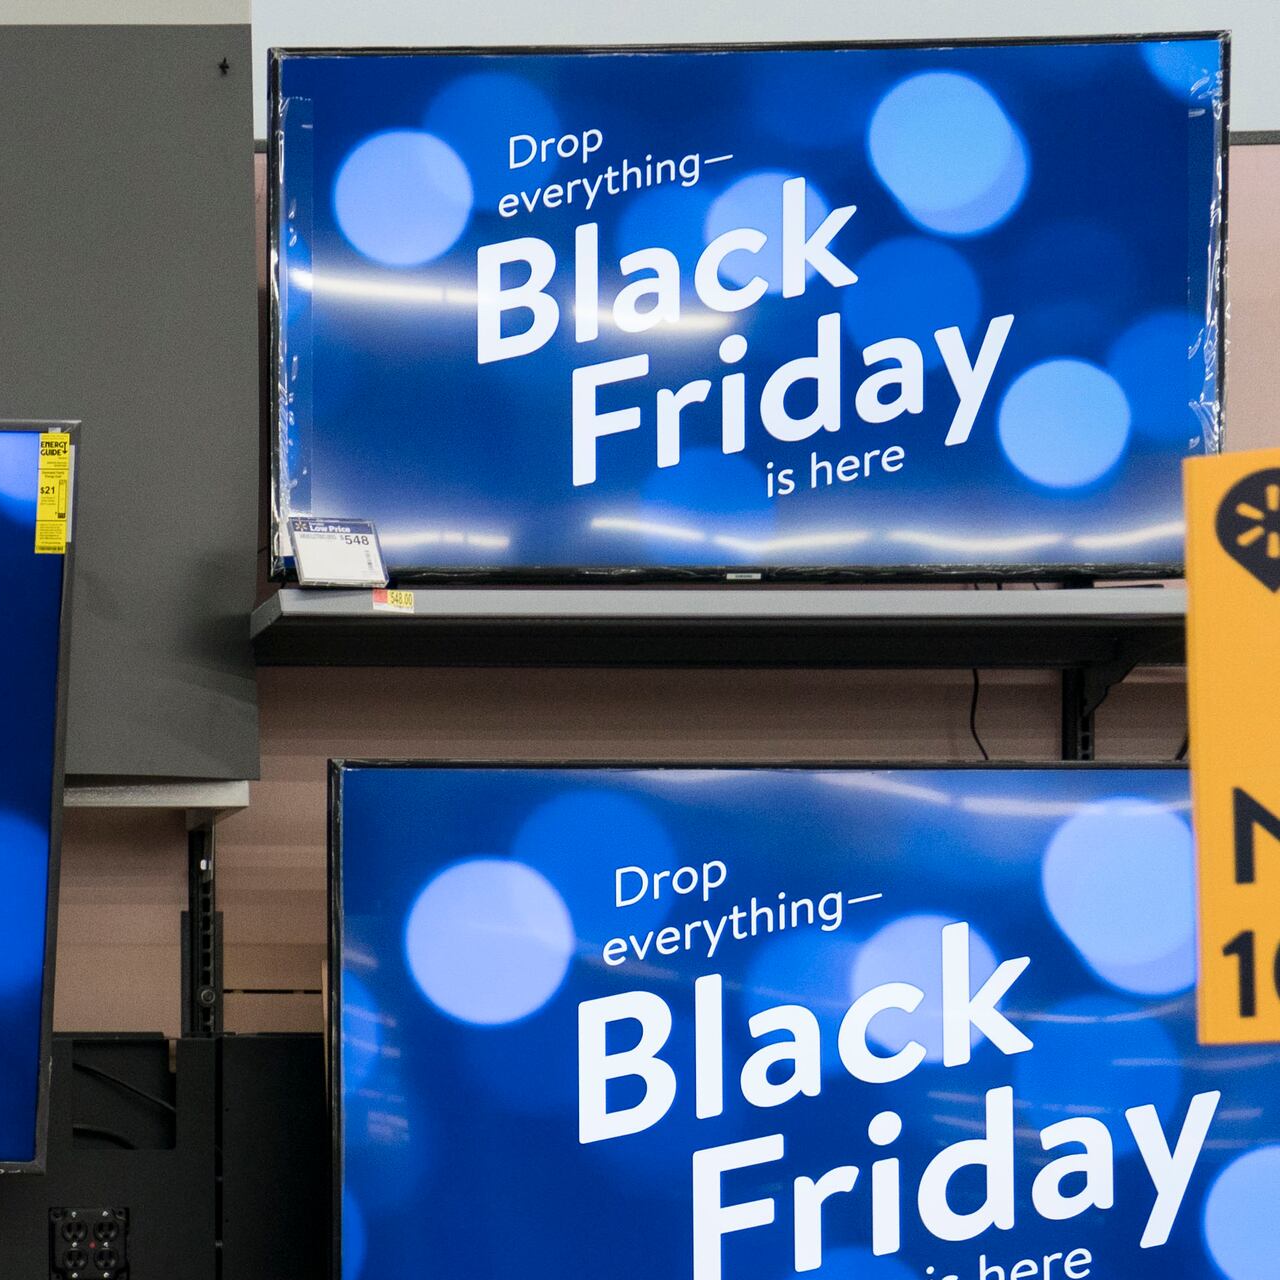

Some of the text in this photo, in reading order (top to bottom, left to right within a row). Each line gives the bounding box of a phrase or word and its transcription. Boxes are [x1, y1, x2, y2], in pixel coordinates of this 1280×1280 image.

[509, 129, 603, 169] Drop
[477, 177, 858, 364] Black
[573, 313, 1014, 487] Friday
[40, 486, 56, 494] $21
[766, 446, 905, 498] is here
[615, 860, 727, 908] Drop
[578, 921, 1034, 1144] Black
